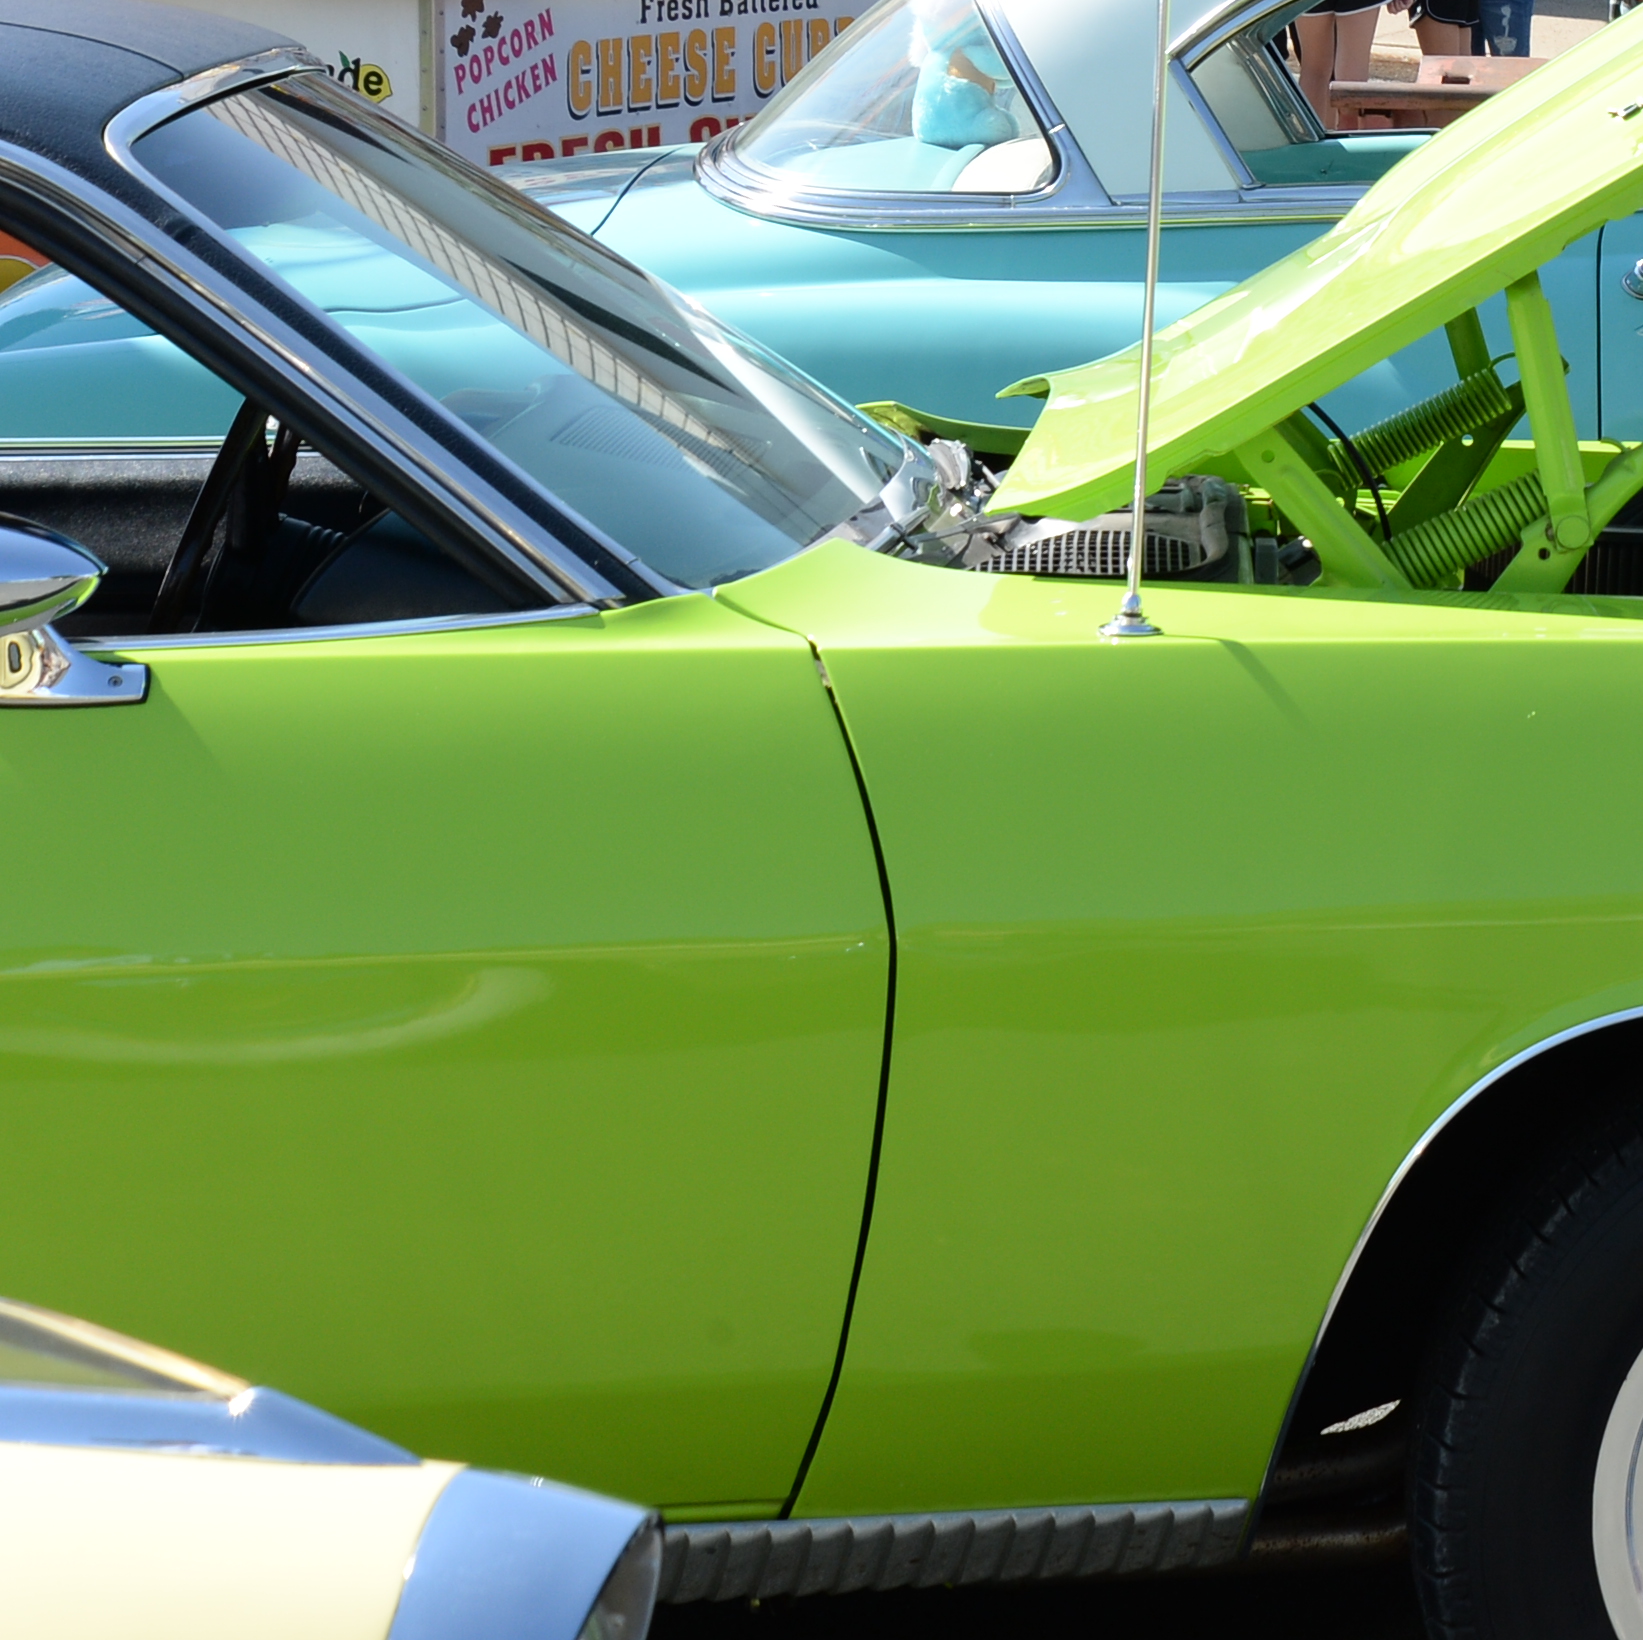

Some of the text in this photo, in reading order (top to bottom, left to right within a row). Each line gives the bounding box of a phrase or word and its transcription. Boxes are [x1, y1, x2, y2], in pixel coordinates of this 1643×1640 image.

[452, 7, 555, 96] POPCORN
[466, 52, 558, 133] CHICKEN
[567, 15, 858, 121] CHEESE CUR
